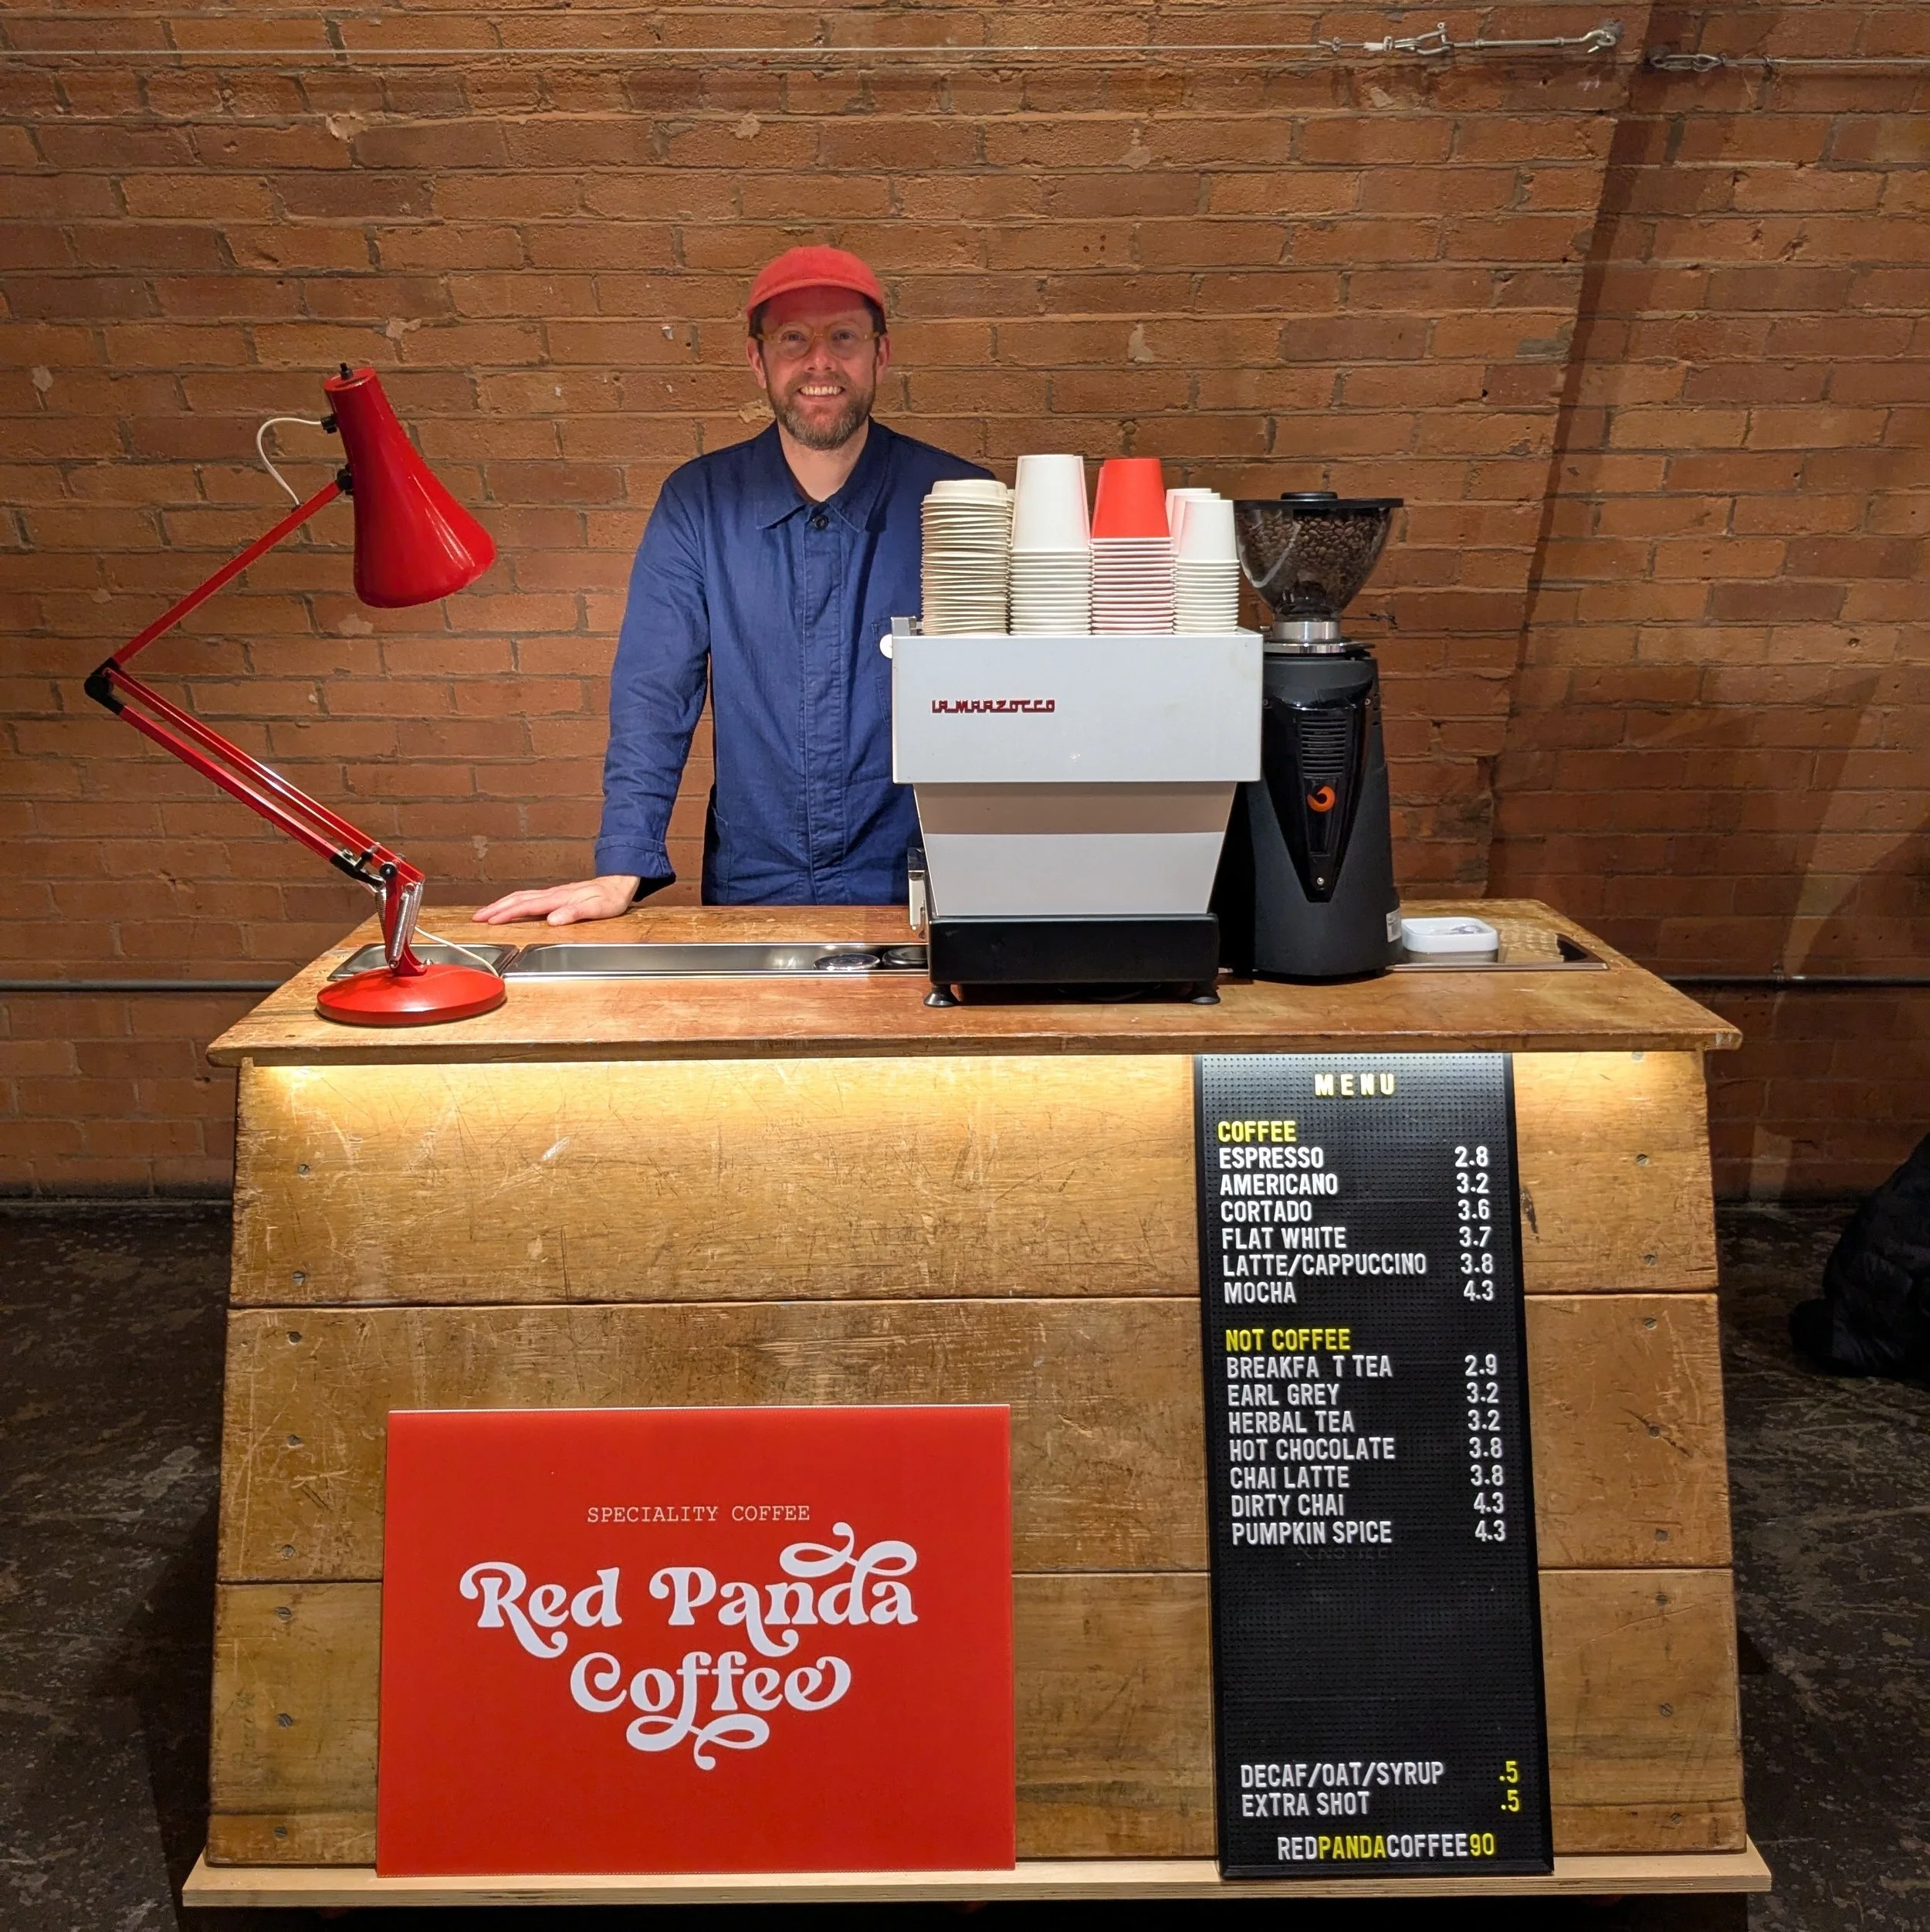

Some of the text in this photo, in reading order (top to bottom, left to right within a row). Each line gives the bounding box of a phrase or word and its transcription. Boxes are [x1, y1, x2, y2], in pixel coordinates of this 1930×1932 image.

[1315, 1074, 1395, 1096] MENU
[1217, 1120, 1296, 1142] COFFEE
[1219, 1146, 1488, 1168] ESPRESSO 2.8
[1220, 1173, 1488, 1195] AMERICANO 3.2
[1221, 1199, 1489, 1222] CORTADO 3.6
[1222, 1226, 1492, 1249] FLAT WHITE 3.7
[1223, 1253, 1493, 1276] LATTE/CAPPUCCINO 3.8
[1224, 1280, 1494, 1303] MOCHA 4.3
[1226, 1329, 1350, 1351] NOT COFFEE
[1353, 1355, 1393, 1377] TEA
[1464, 1354, 1497, 1375] 2.9
[1227, 1382, 1499, 1405] EARL GREY 3.2
[1229, 1410, 1500, 1433] HERBAL TEA 3.2
[1229, 1437, 1502, 1461] HOT CHOCOLATE 3.8
[1231, 1465, 1504, 1489] CHAI LATTE 3.8
[587, 1505, 810, 1523] SPECIALITY COFFEE
[1231, 1493, 1504, 1517] DIRTY CHAI 4.3
[1232, 1520, 1506, 1544] PUMPKIN SPICE 4.3
[459, 1522, 919, 1659] Red Panda
[570, 1651, 851, 1771] Coffee
[1241, 1761, 1518, 1788] DECAF/OAT/SYRUP .5
[1241, 1790, 1520, 1817] EXTRA SHOT .5
